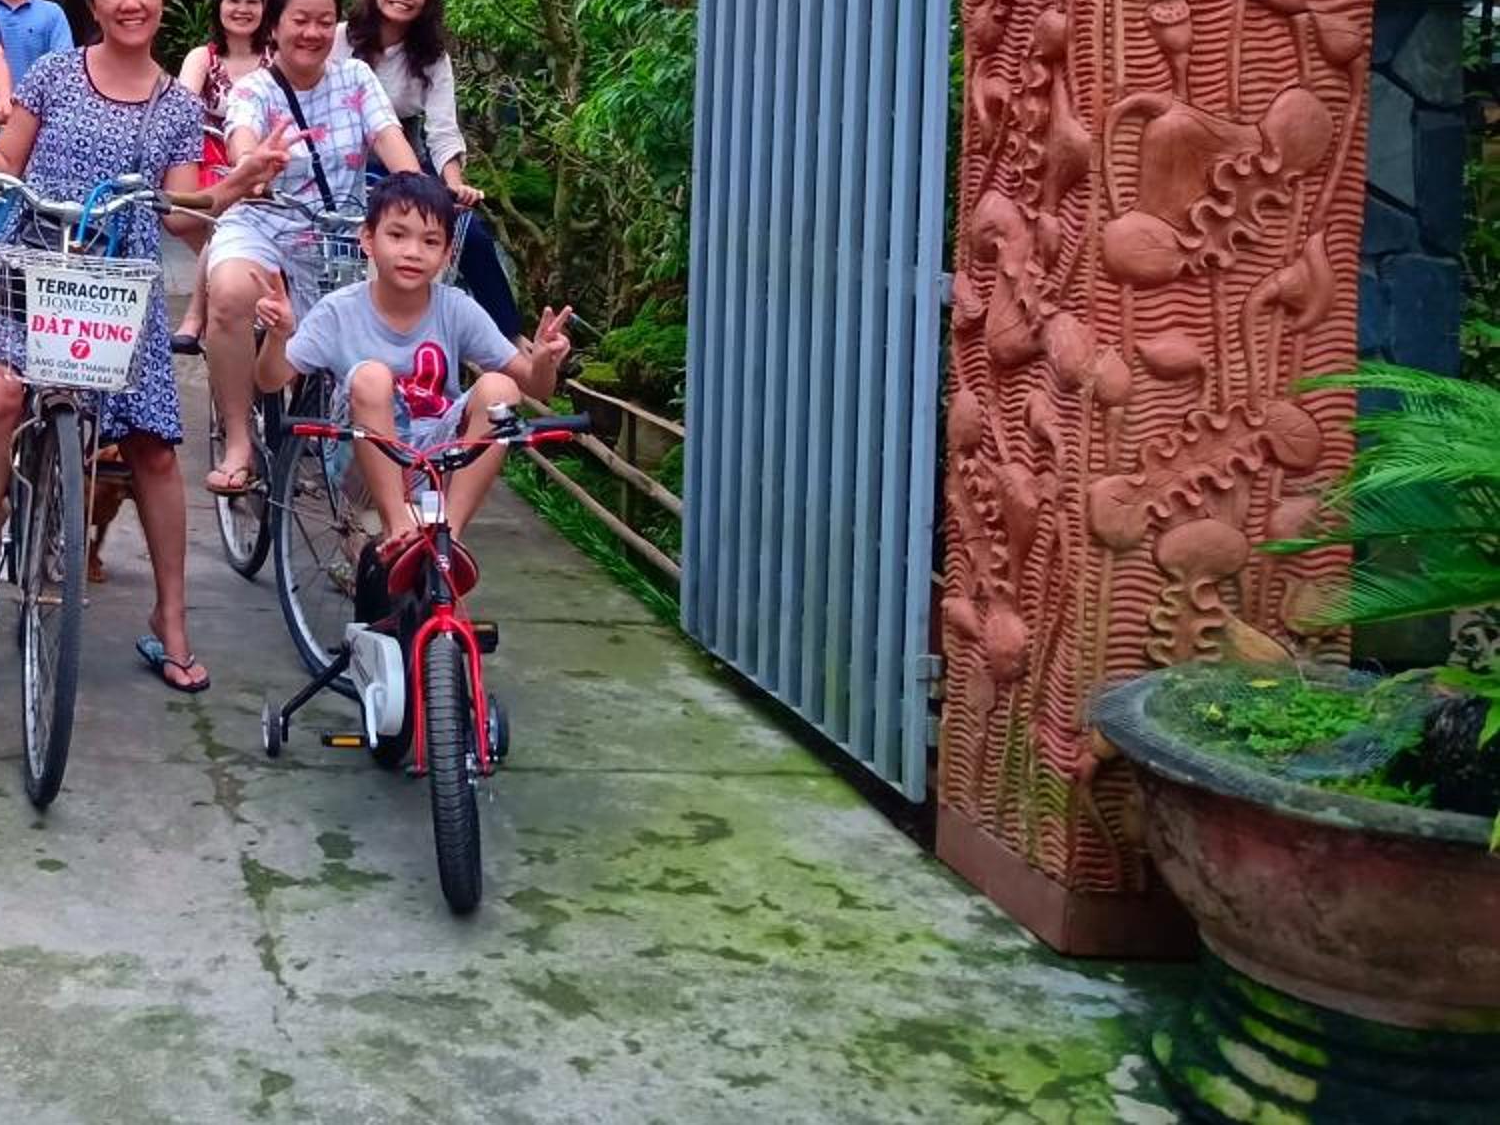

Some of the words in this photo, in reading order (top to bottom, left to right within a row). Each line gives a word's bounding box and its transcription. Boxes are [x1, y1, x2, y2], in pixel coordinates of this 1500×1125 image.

[36, 277, 138, 304] TERRACOTTA
[39, 295, 132, 317] HOMESTAY
[78, 320, 133, 343] NUNG
